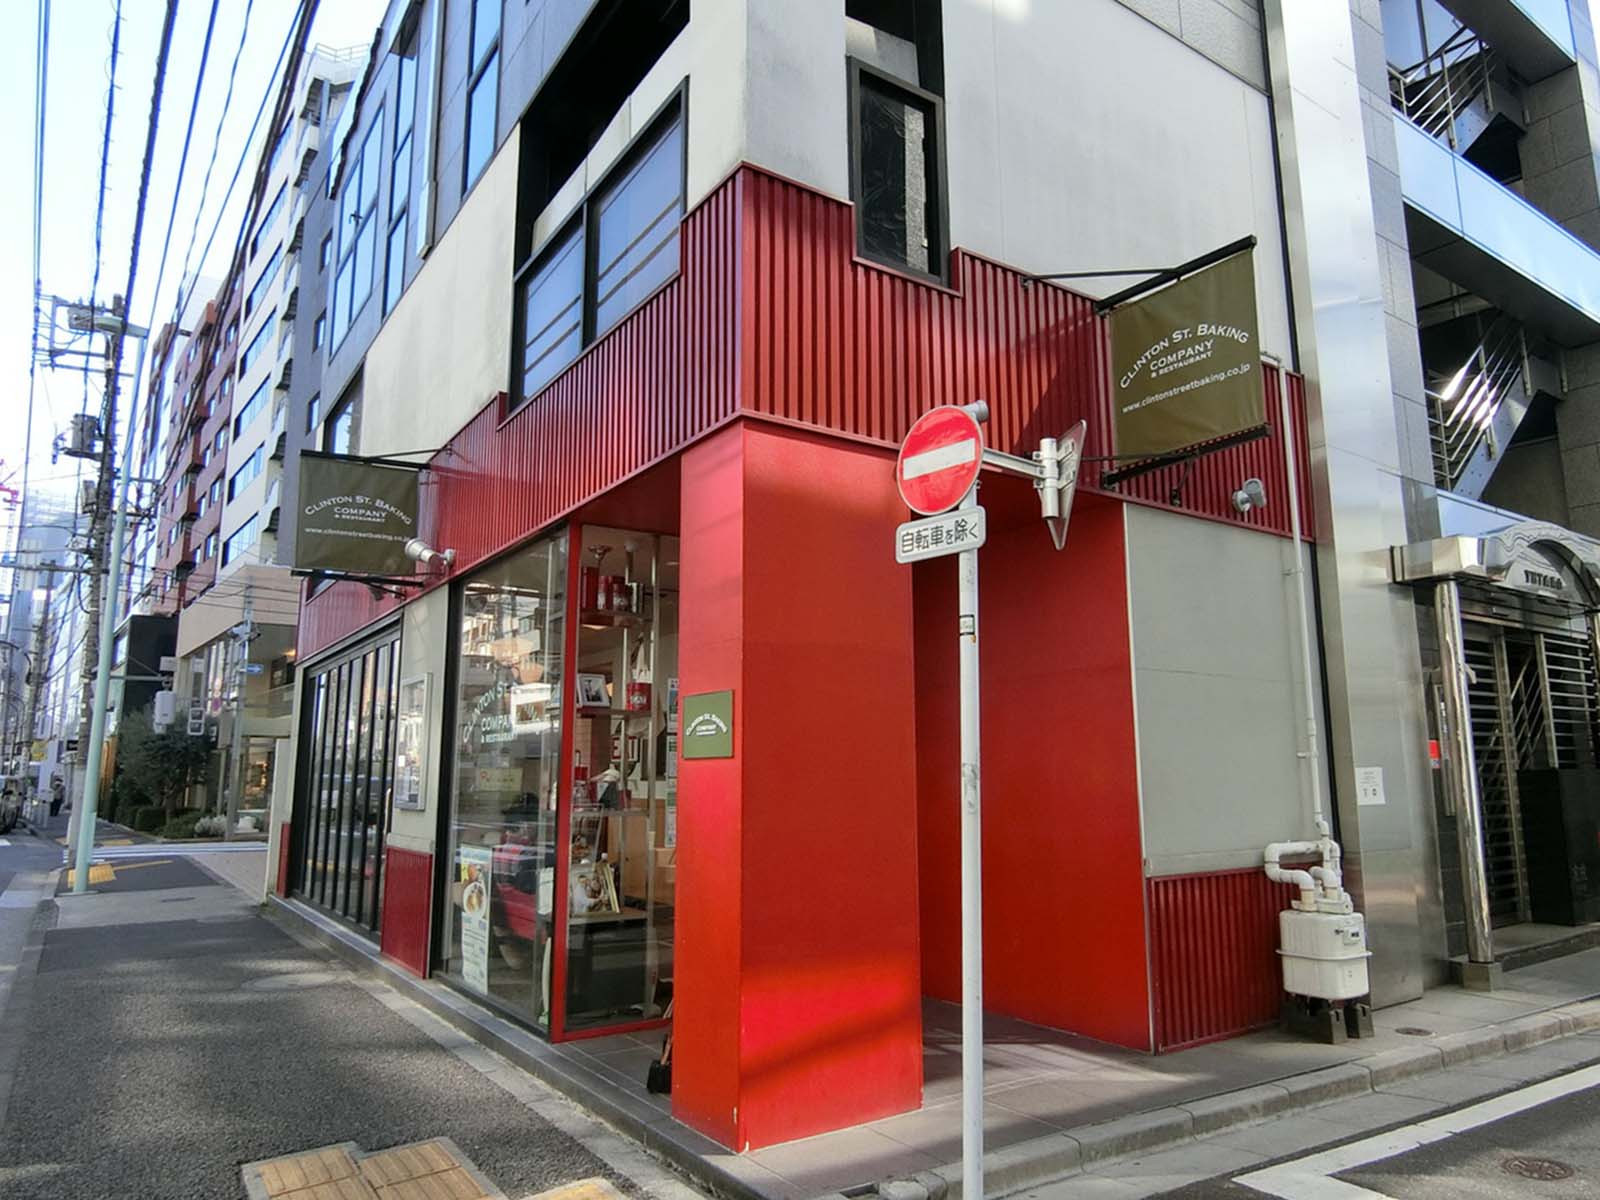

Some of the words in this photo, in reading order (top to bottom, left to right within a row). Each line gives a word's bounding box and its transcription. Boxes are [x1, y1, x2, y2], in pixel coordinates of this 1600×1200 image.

[1120, 338, 1169, 388] CLINTON
[1172, 328, 1192, 342] ST.
[1197, 324, 1249, 344] BAKING
[1150, 339, 1214, 371] COMPANY
[1159, 351, 1213, 375] RESTAURANT
[1122, 363, 1250, 413] www.clintonstreetbaking.co.jp
[305, 496, 352, 515] CLINTON
[355, 496, 372, 505] ST.
[375, 499, 412, 525] BAKING
[334, 507, 386, 518] COMPANY
[902, 519, 978, 553] 自転車を除く
